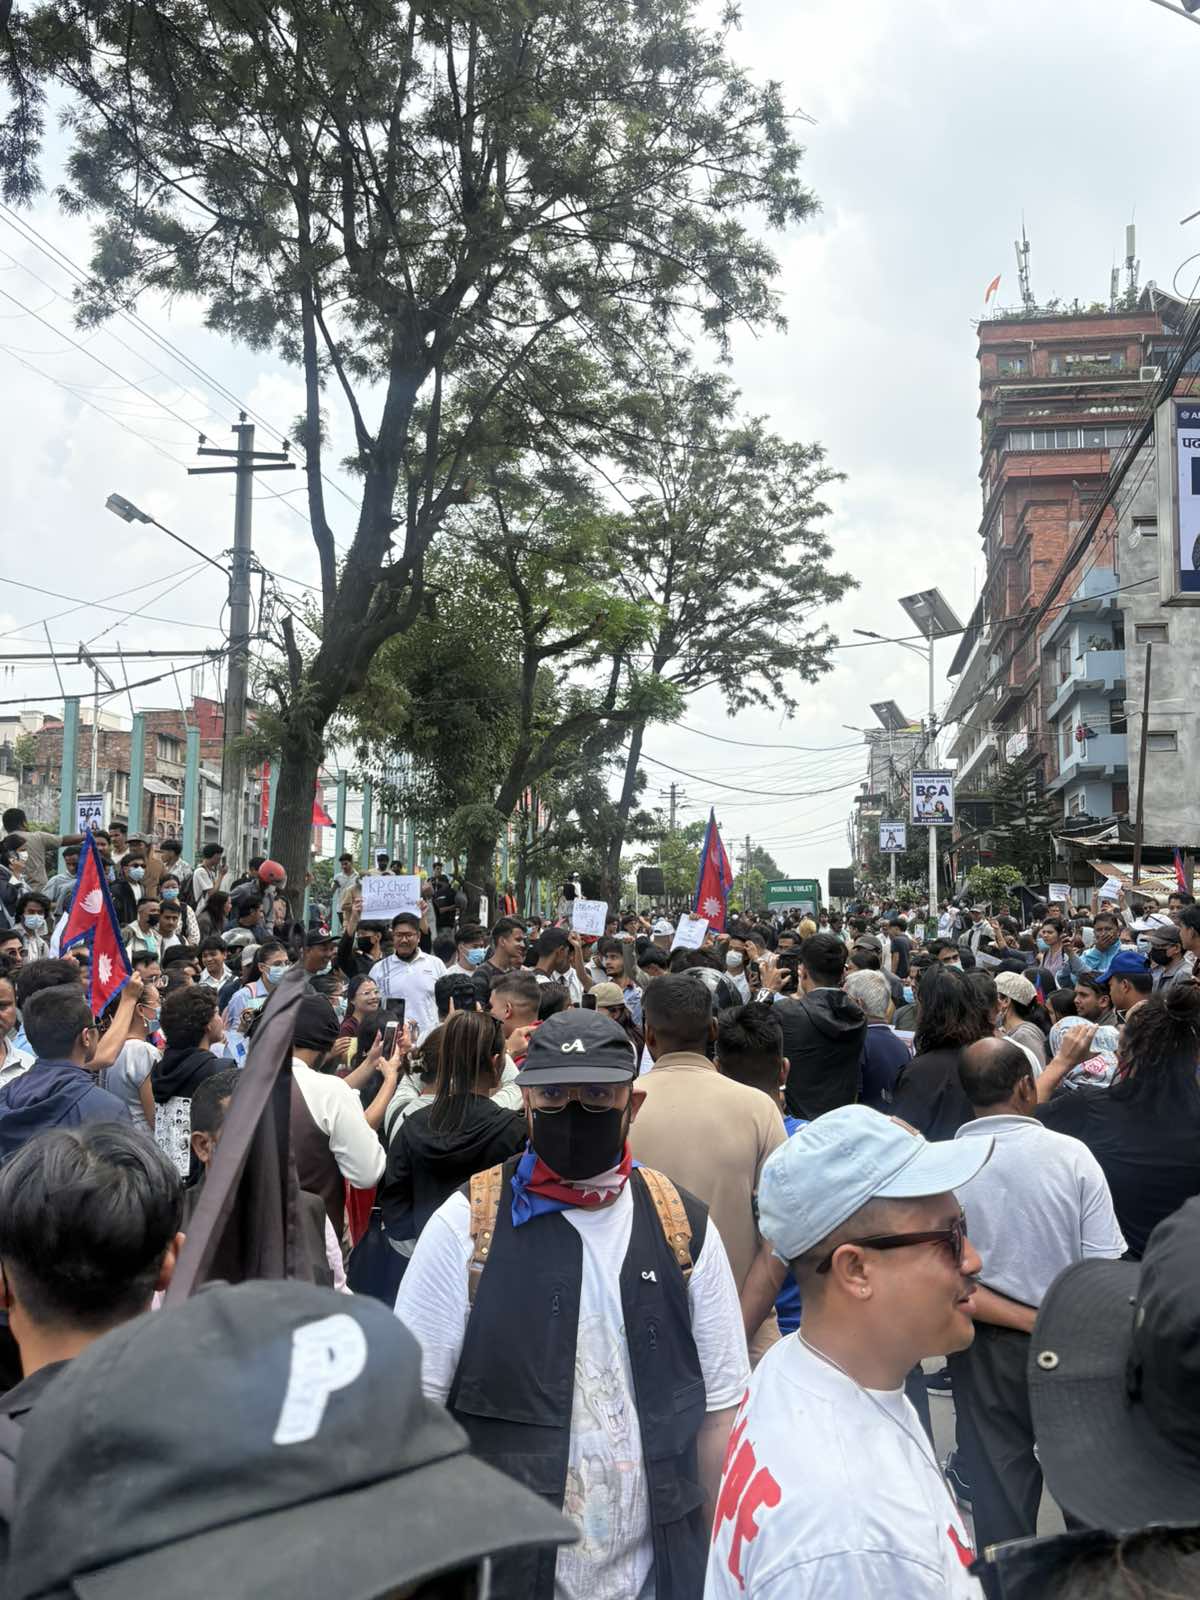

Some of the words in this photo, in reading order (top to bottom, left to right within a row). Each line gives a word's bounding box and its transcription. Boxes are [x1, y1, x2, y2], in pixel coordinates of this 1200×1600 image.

[916, 785, 949, 796] BCA
[80, 807, 101, 817] BCA
[369, 880, 385, 896] KP
[793, 884, 813, 892] TOILET
[273, 1313, 367, 1445] P
